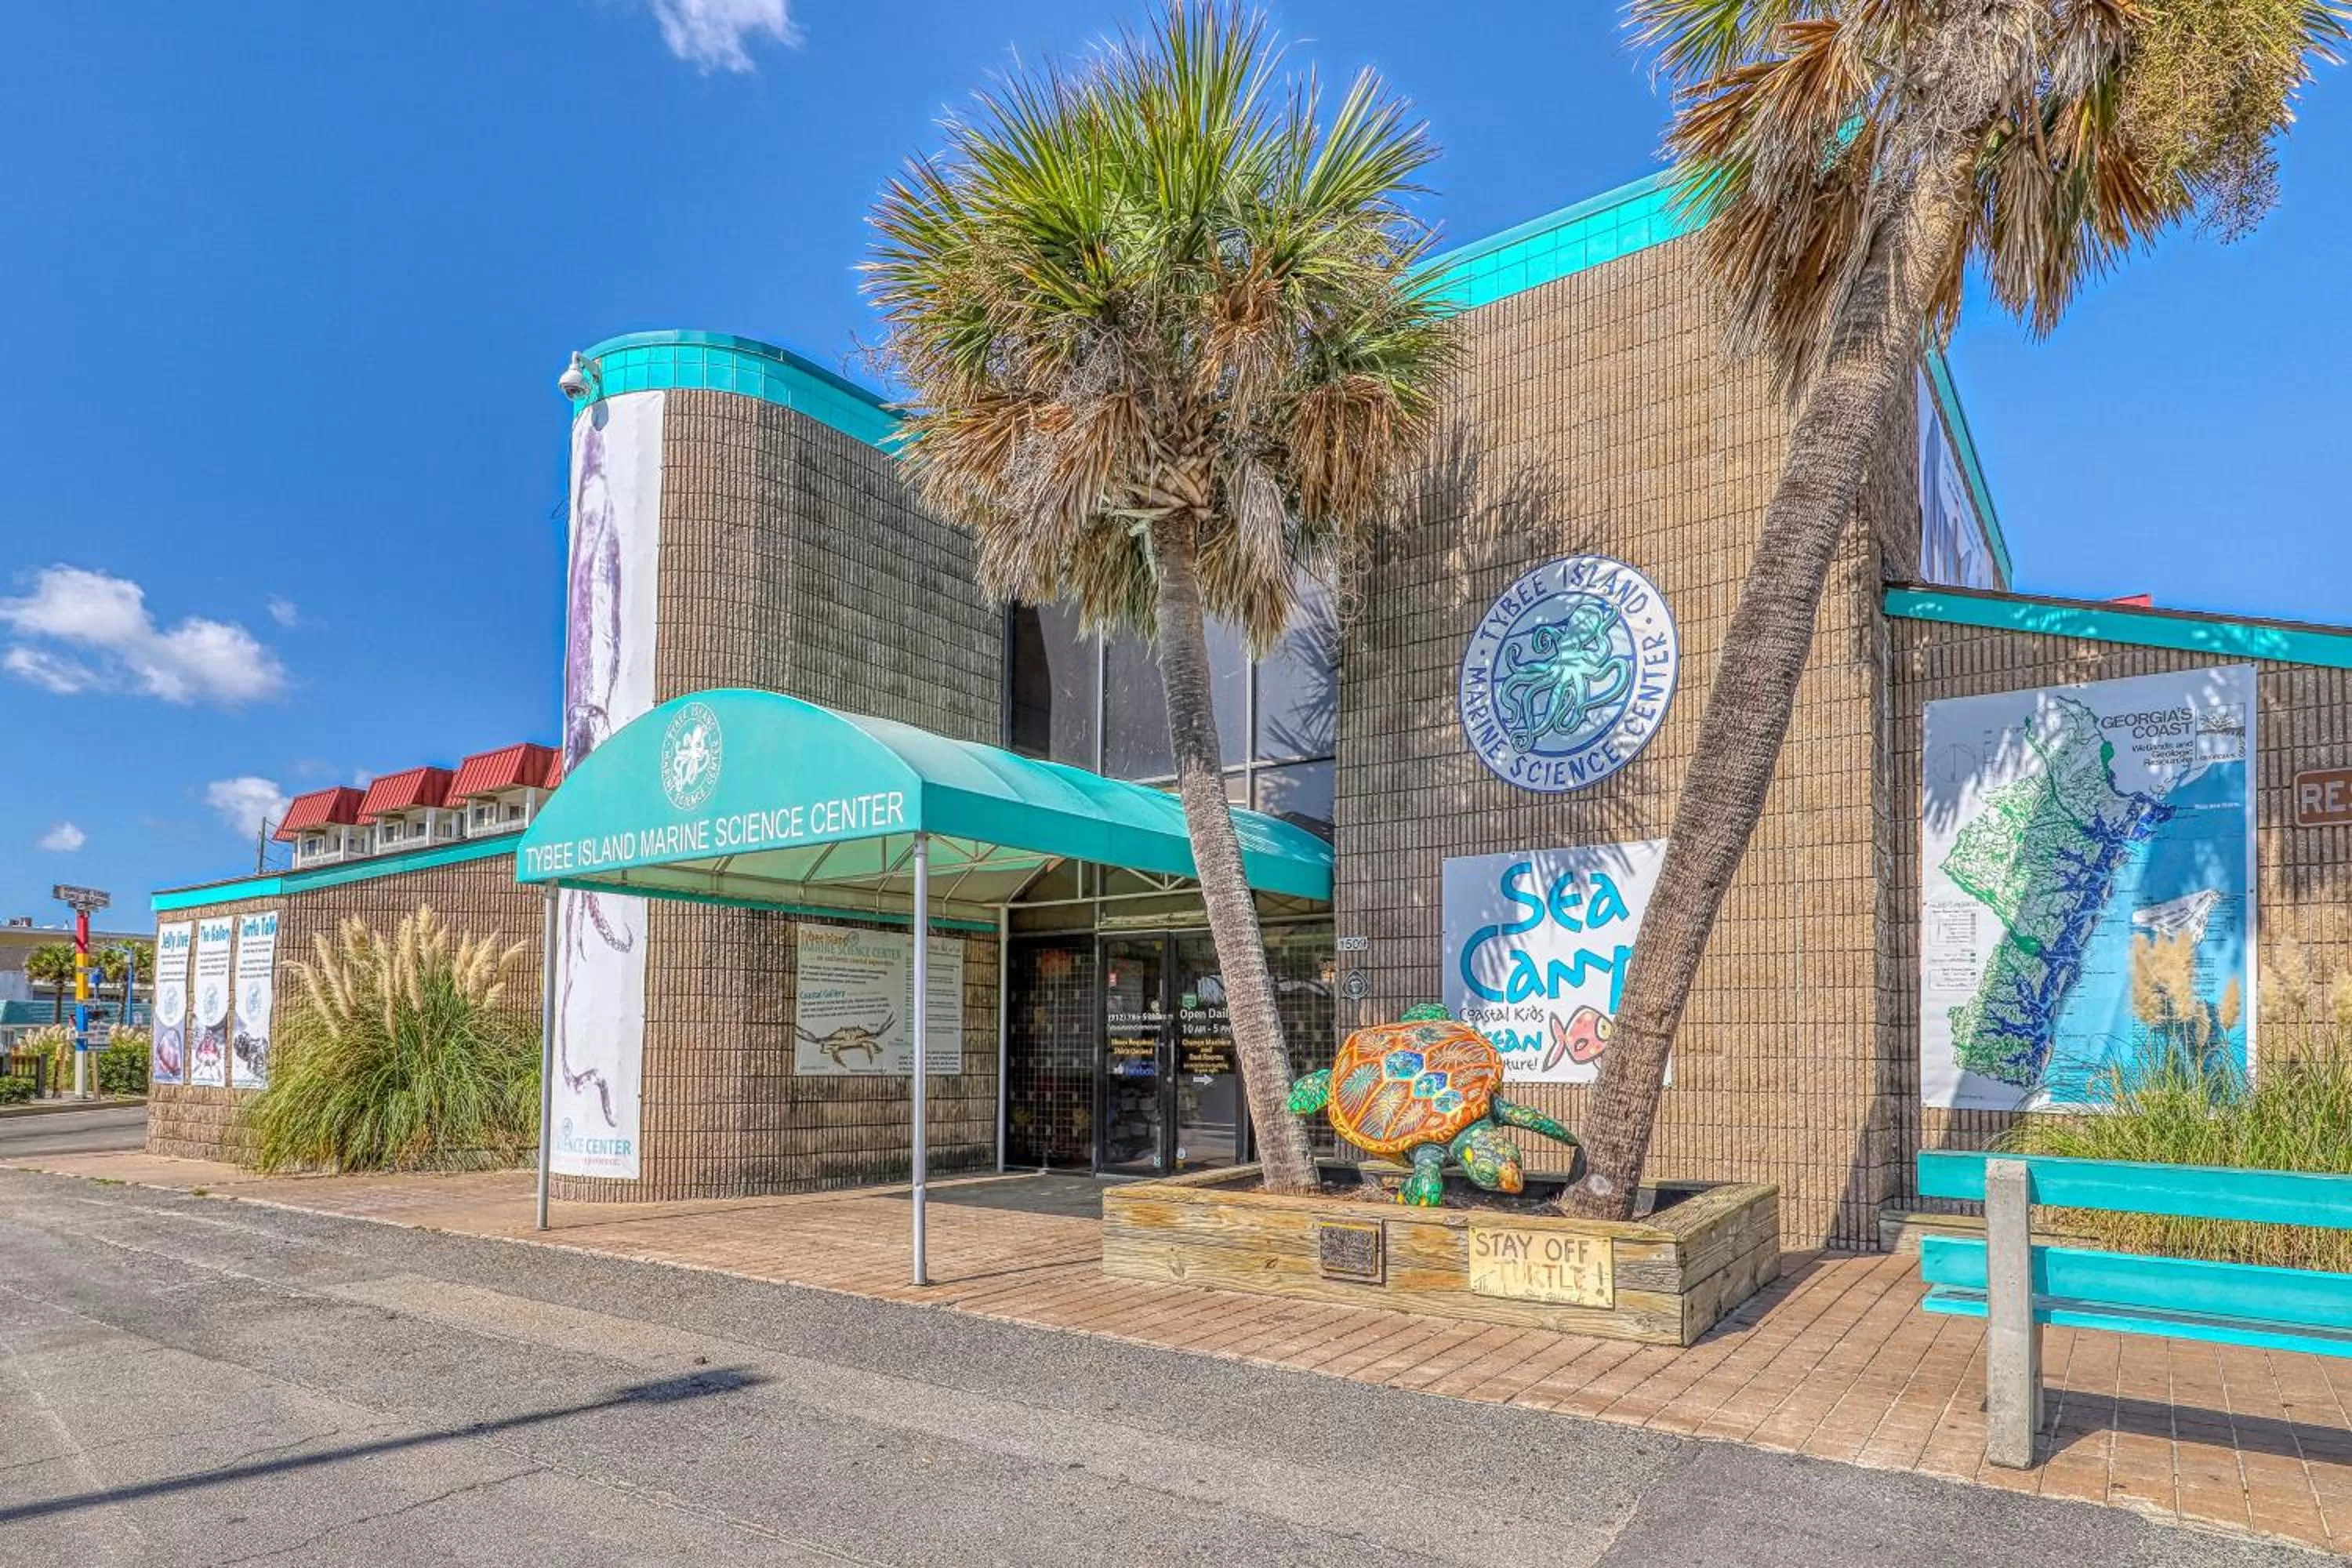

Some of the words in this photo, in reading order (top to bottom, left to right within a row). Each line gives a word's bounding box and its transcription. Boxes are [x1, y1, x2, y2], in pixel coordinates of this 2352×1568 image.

[1480, 572, 1548, 641] TYBEE
[1562, 563, 1650, 615] ISLAND
[1464, 666, 1508, 760] MARINE
[1509, 739, 1621, 786] SCIENCE
[1624, 631, 1669, 736] CENTER
[2100, 707, 2193, 729] GEORGIA'S
[2132, 722, 2193, 739] COAST
[2301, 780, 2352, 815] RE
[525, 842, 574, 873] TYBEE
[578, 833, 636, 866] ISLAND
[640, 820, 710, 858] MARINE
[716, 807, 804, 849] SCIENCE
[810, 791, 904, 831] CENTER
[1500, 860, 1630, 936] Sea
[1180, 1007, 1207, 1022] Open
[1208, 1007, 1229, 1018] Dail
[1459, 1006, 1510, 1023] Coastal
[1514, 1004, 1544, 1023] Kids
[1182, 1024, 1193, 1033] 10
[1213, 1024, 1218, 1033] 5
[585, 1138, 631, 1155] CENTER
[1475, 1232, 1533, 1259] STAY
[1545, 1238, 1589, 1264] OFF
